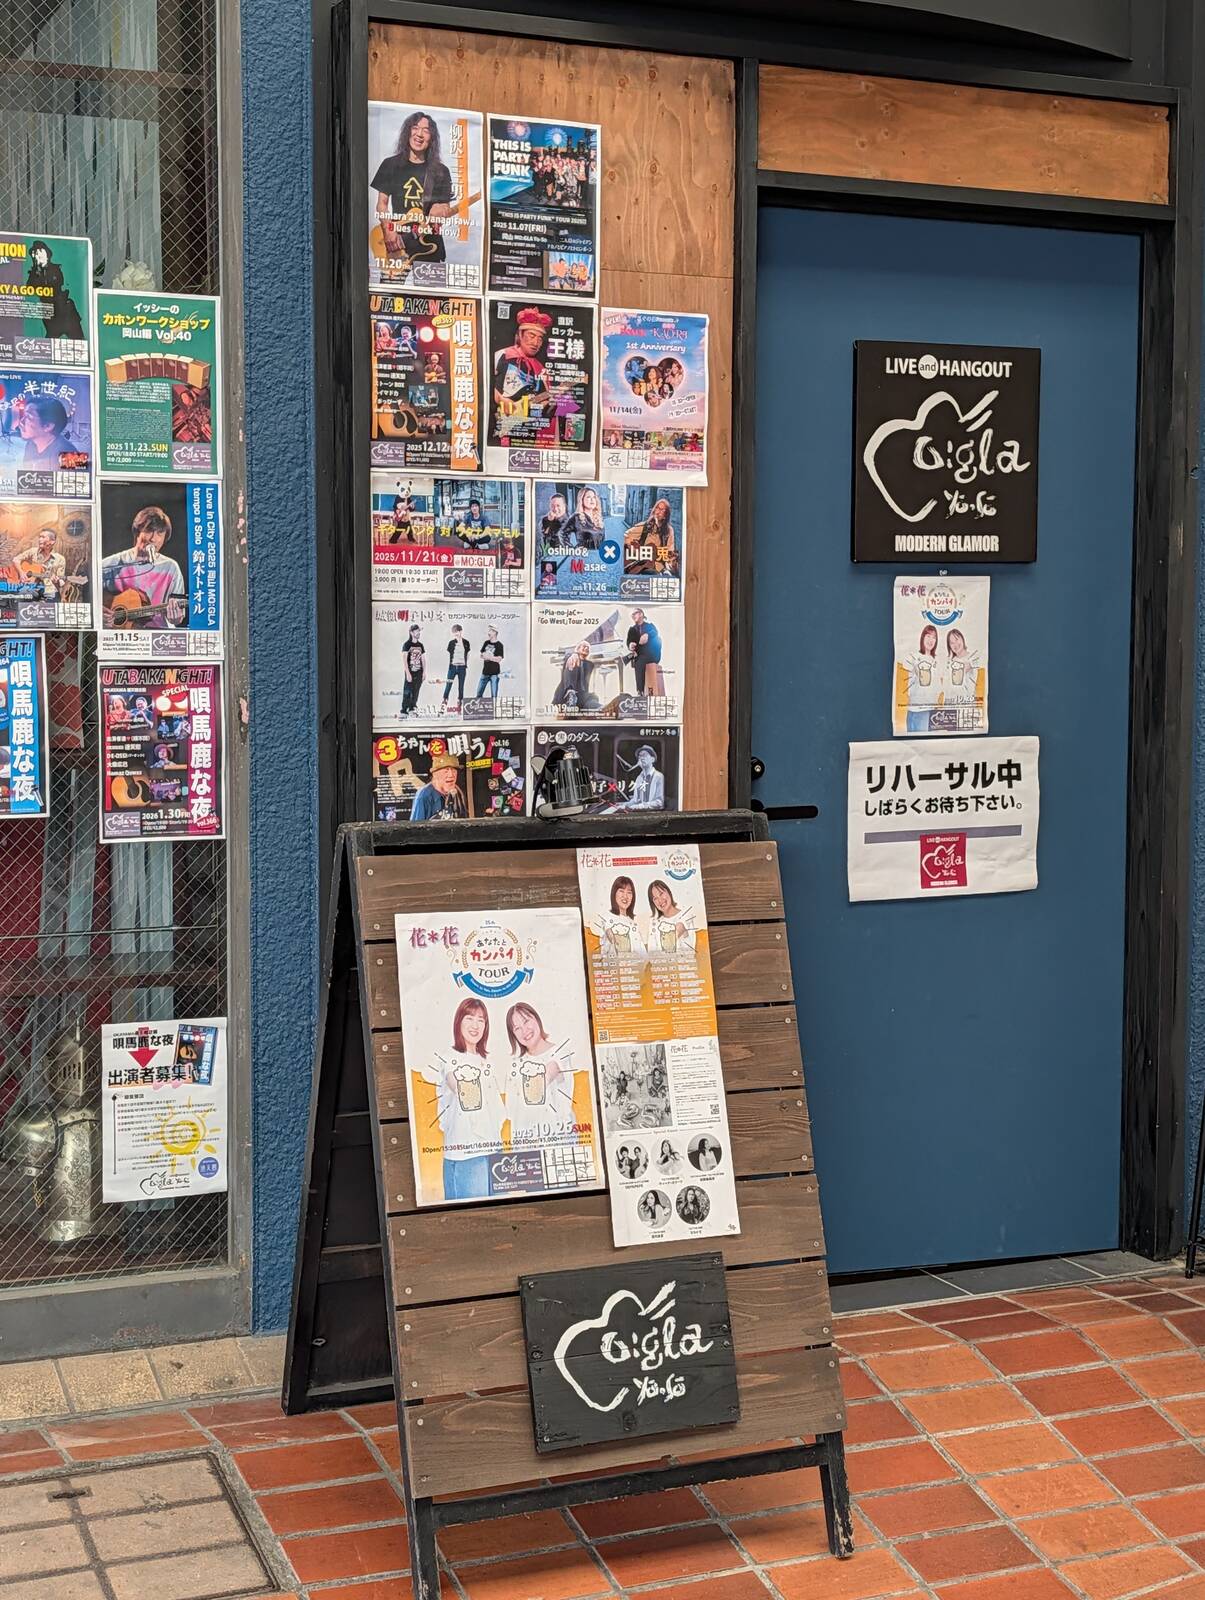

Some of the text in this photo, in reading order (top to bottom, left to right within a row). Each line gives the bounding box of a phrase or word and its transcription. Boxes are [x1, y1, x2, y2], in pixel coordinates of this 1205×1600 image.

[493, 140, 532, 150] THIS IS
[494, 151, 530, 163] PARTY
[494, 162, 530, 176] FUNK
[375, 258, 402, 268] 11.20
[20, 286, 34, 296] GO
[36, 287, 54, 297] GO!
[133, 303, 180, 314] イッシーの
[155, 330, 192, 341] Vol.40
[552, 328, 582, 336] ロッカー
[547, 338, 585, 360] 王様
[640, 342, 686, 354] Anniversary
[886, 357, 1012, 378] LIVE and HANGOUT
[452, 320, 474, 458] 唄馬鹿な夜
[422, 442, 447, 452] 12.12
[206, 488, 214, 510] Love
[207, 522, 215, 540] City
[895, 535, 1000, 552] MODERN GLAMOR
[208, 542, 216, 568] 2025
[375, 550, 453, 564] 2025/11/21(金)
[571, 560, 606, 574] Masae
[584, 582, 606, 591] 11.26
[208, 588, 216, 626] MO:GLA
[114, 633, 139, 642] 11.15
[162, 685, 190, 698] SPECIAL
[10, 660, 35, 802] 唄馬鹿な夜
[190, 687, 212, 822] 唄馬鹿な夜
[866, 759, 1022, 793] リハーサル中
[864, 794, 1022, 816] しばらくお待ち下さい。
[158, 809, 180, 819] 1.30
[476, 938, 507, 948] あなたと
[470, 947, 514, 962] カンパイ
[478, 967, 510, 978] TOUR
[113, 1034, 174, 1050] 唄馬鹿な夜
[108, 1064, 192, 1086] 出演者募集!
[512, 1122, 592, 1139] 2025 10.26 SUN
